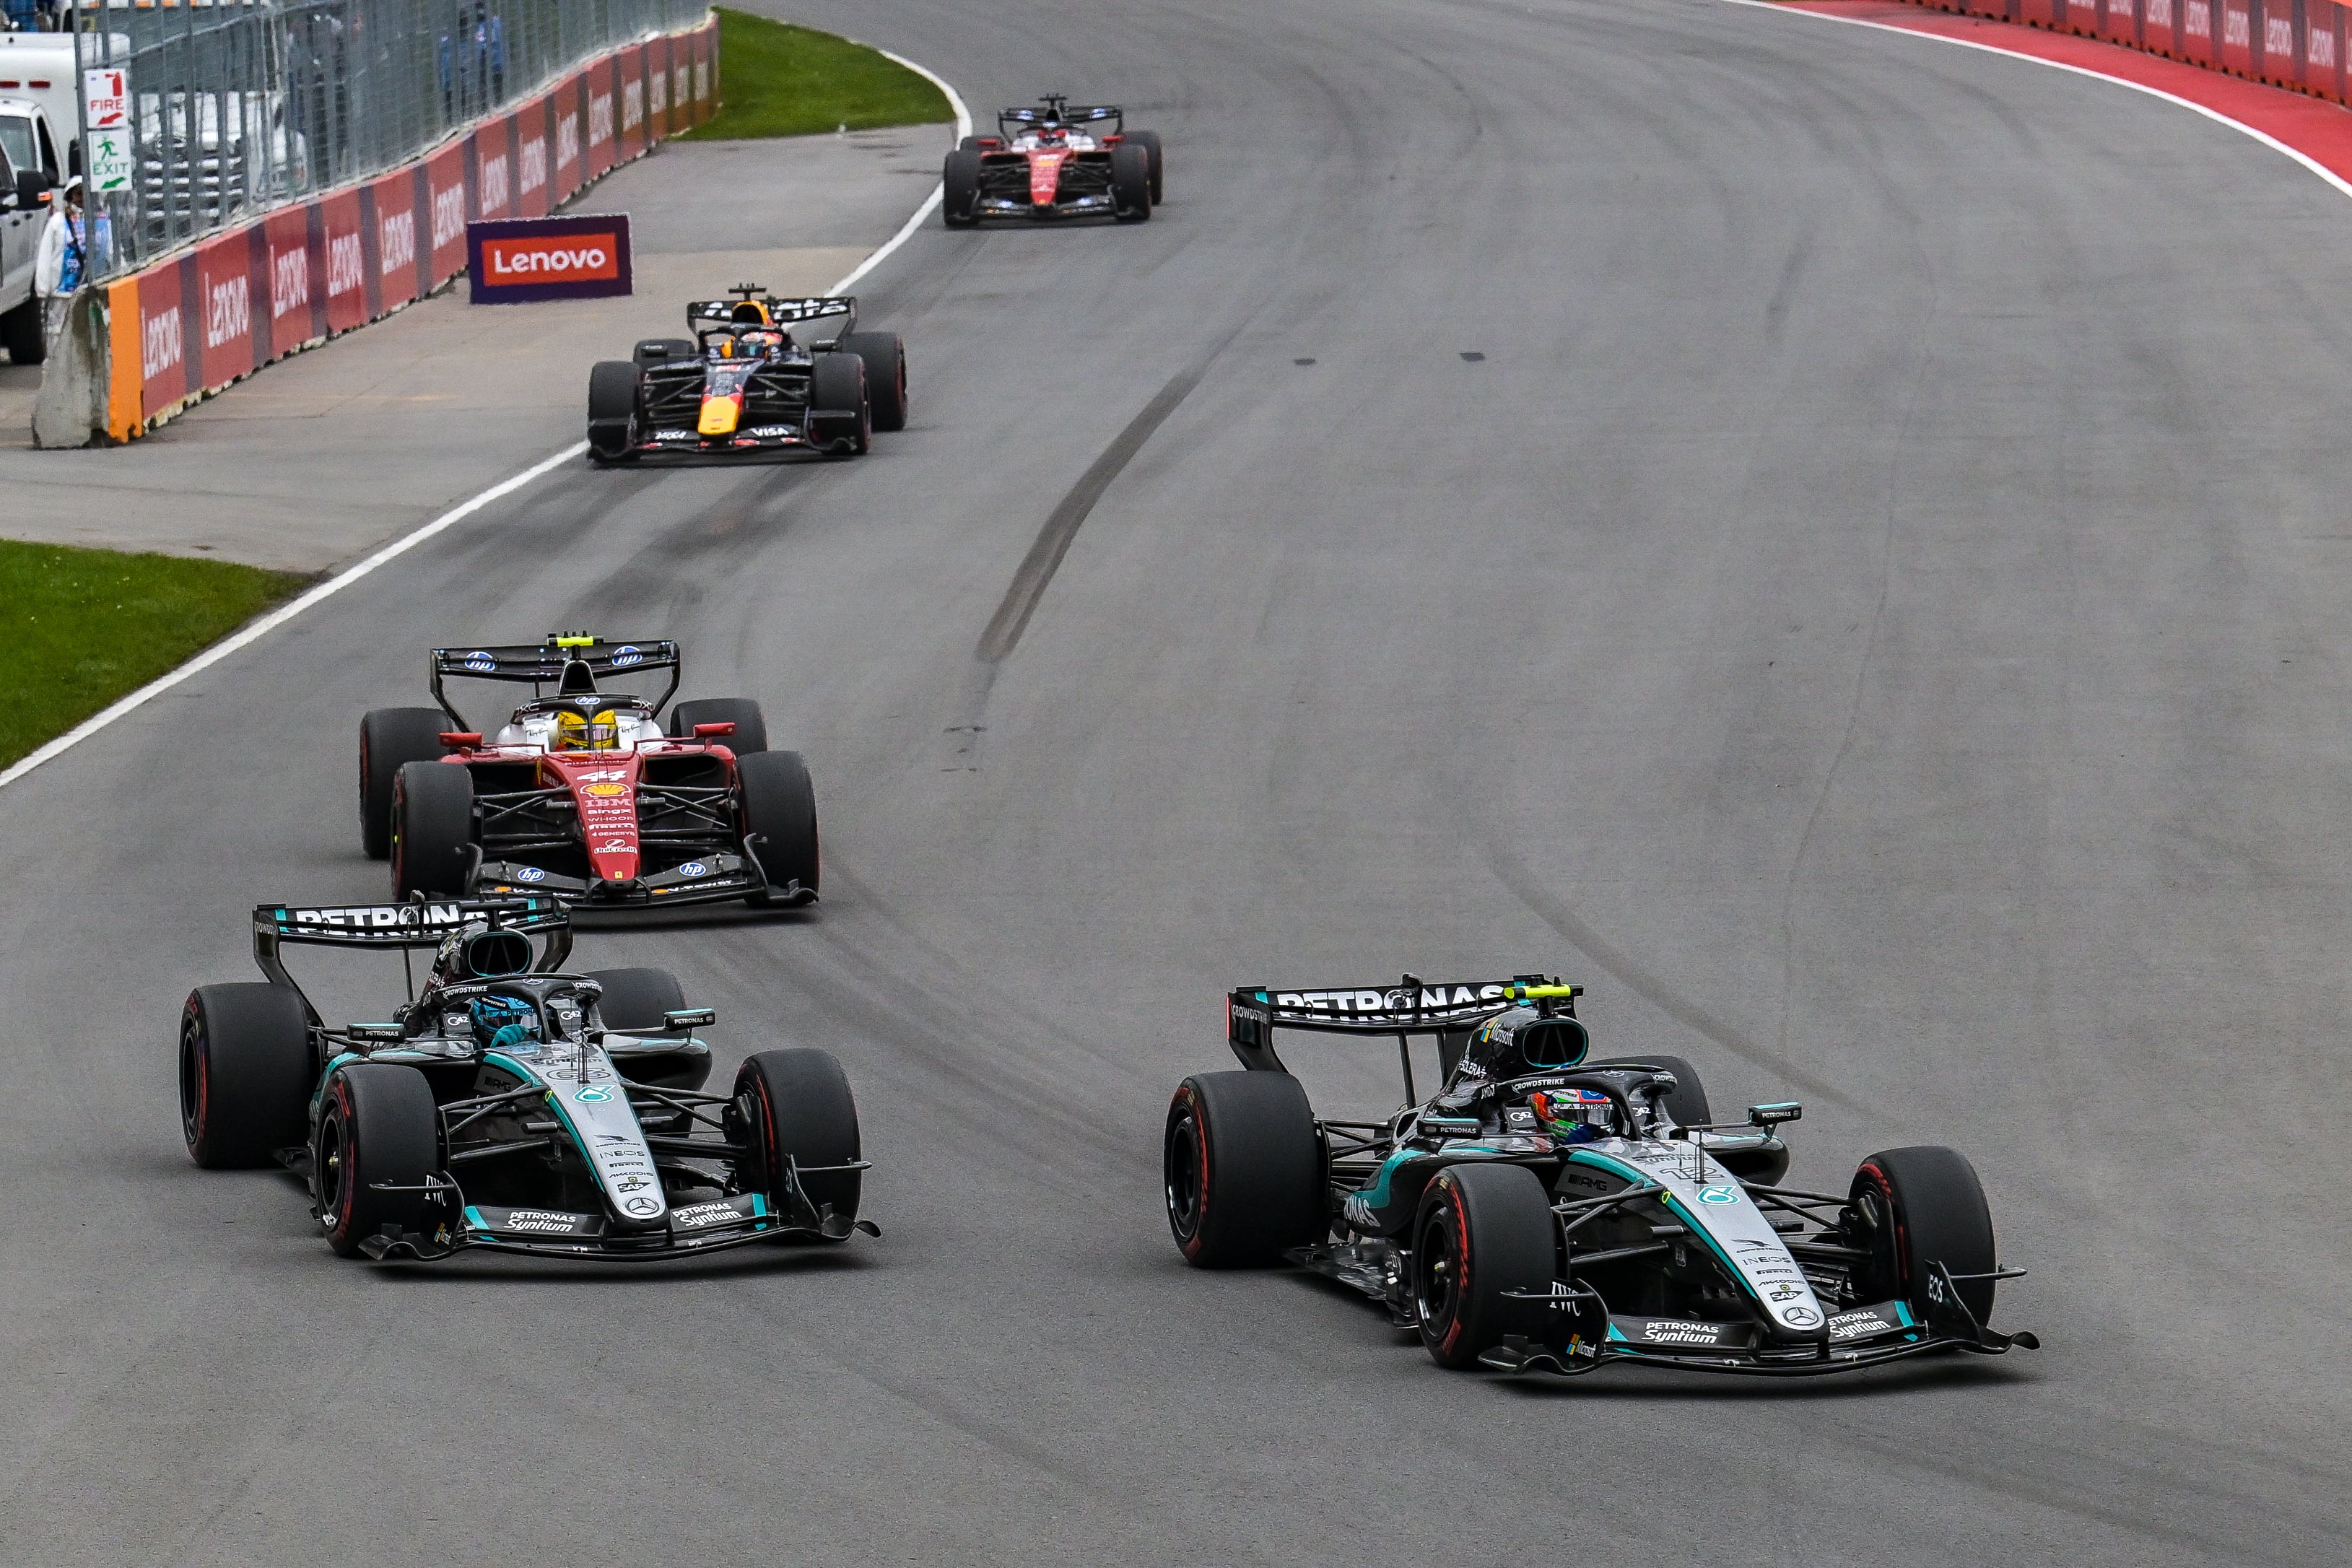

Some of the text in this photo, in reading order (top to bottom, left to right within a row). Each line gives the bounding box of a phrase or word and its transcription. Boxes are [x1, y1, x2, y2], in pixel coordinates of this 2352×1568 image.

[90, 99, 124, 112] FIRE
[93, 162, 129, 175] EXIT
[494, 248, 606, 274] Lenovo
[204, 271, 249, 348] Lenovo
[141, 306, 181, 380] Lenovo
[749, 427, 789, 437] VISA
[577, 696, 598, 705] hp
[577, 770, 627, 782] 44
[585, 798, 632, 807] IBM
[520, 868, 543, 881] hp
[681, 863, 705, 876] hp
[443, 985, 488, 996] CROWDSTRIKE
[1277, 985, 1507, 1022] PETRONAS
[447, 1016, 469, 1026] G42
[560, 1011, 582, 1020] G42
[1489, 1022, 1515, 1047] Microsoft
[1514, 1078, 1565, 1090] CROWDSTRIKE
[1510, 1111, 1533, 1121] G42
[600, 1150, 645, 1159] INEOS
[1659, 1167, 1725, 1180] 12
[1580, 1176, 1607, 1192] AMG
[424, 1174, 447, 1208] IWC
[510, 1211, 577, 1223] PETRONAS
[672, 1203, 733, 1218] PETRONAS
[679, 1210, 743, 1227] Syntium
[504, 1219, 574, 1232] Syntium
[1743, 1256, 1791, 1265] INEOS
[1549, 1281, 1581, 1317] IWC
[1827, 1311, 1878, 1326] ETRONAS
[1646, 1322, 1720, 1333] PETRONAS
[1829, 1320, 1891, 1338] Syntium
[1642, 1329, 1717, 1343] Syntium
[1575, 1339, 1597, 1359] Microsoft
